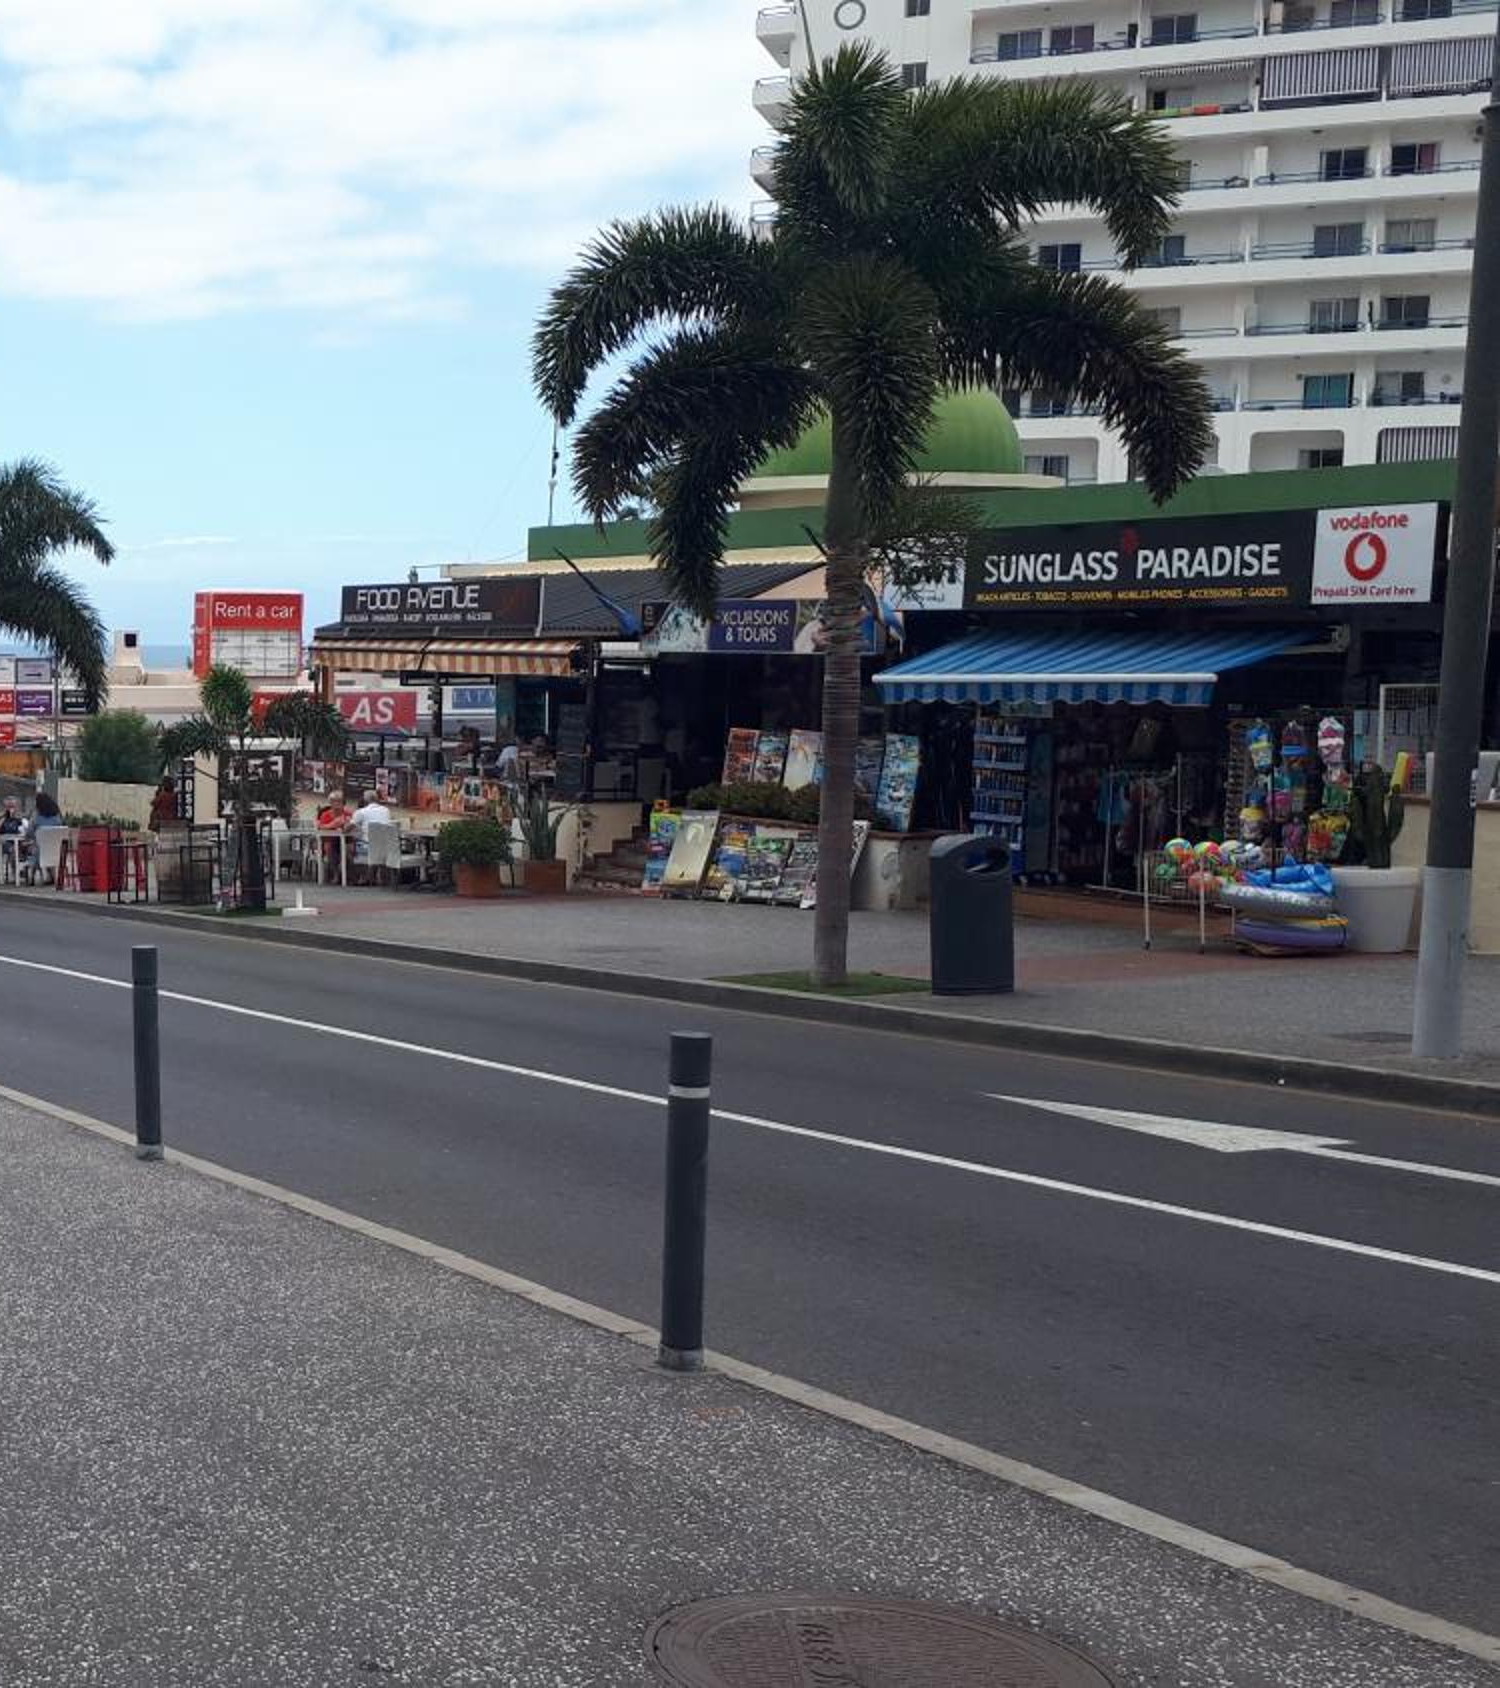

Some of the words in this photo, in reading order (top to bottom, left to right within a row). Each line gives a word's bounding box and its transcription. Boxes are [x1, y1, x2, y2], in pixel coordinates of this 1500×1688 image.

[1329, 510, 1409, 531] vodafone
[983, 551, 1119, 584] SUNGLASS
[1135, 543, 1282, 579] PARADISE
[356, 588, 400, 610] FOOD
[405, 585, 481, 609] AVENUE
[1369, 585, 1392, 597] Card
[214, 602, 252, 618] Rent
[255, 605, 266, 618] a
[271, 604, 296, 618] car
[725, 628, 733, 642] &
[737, 627, 777, 643] TOURS
